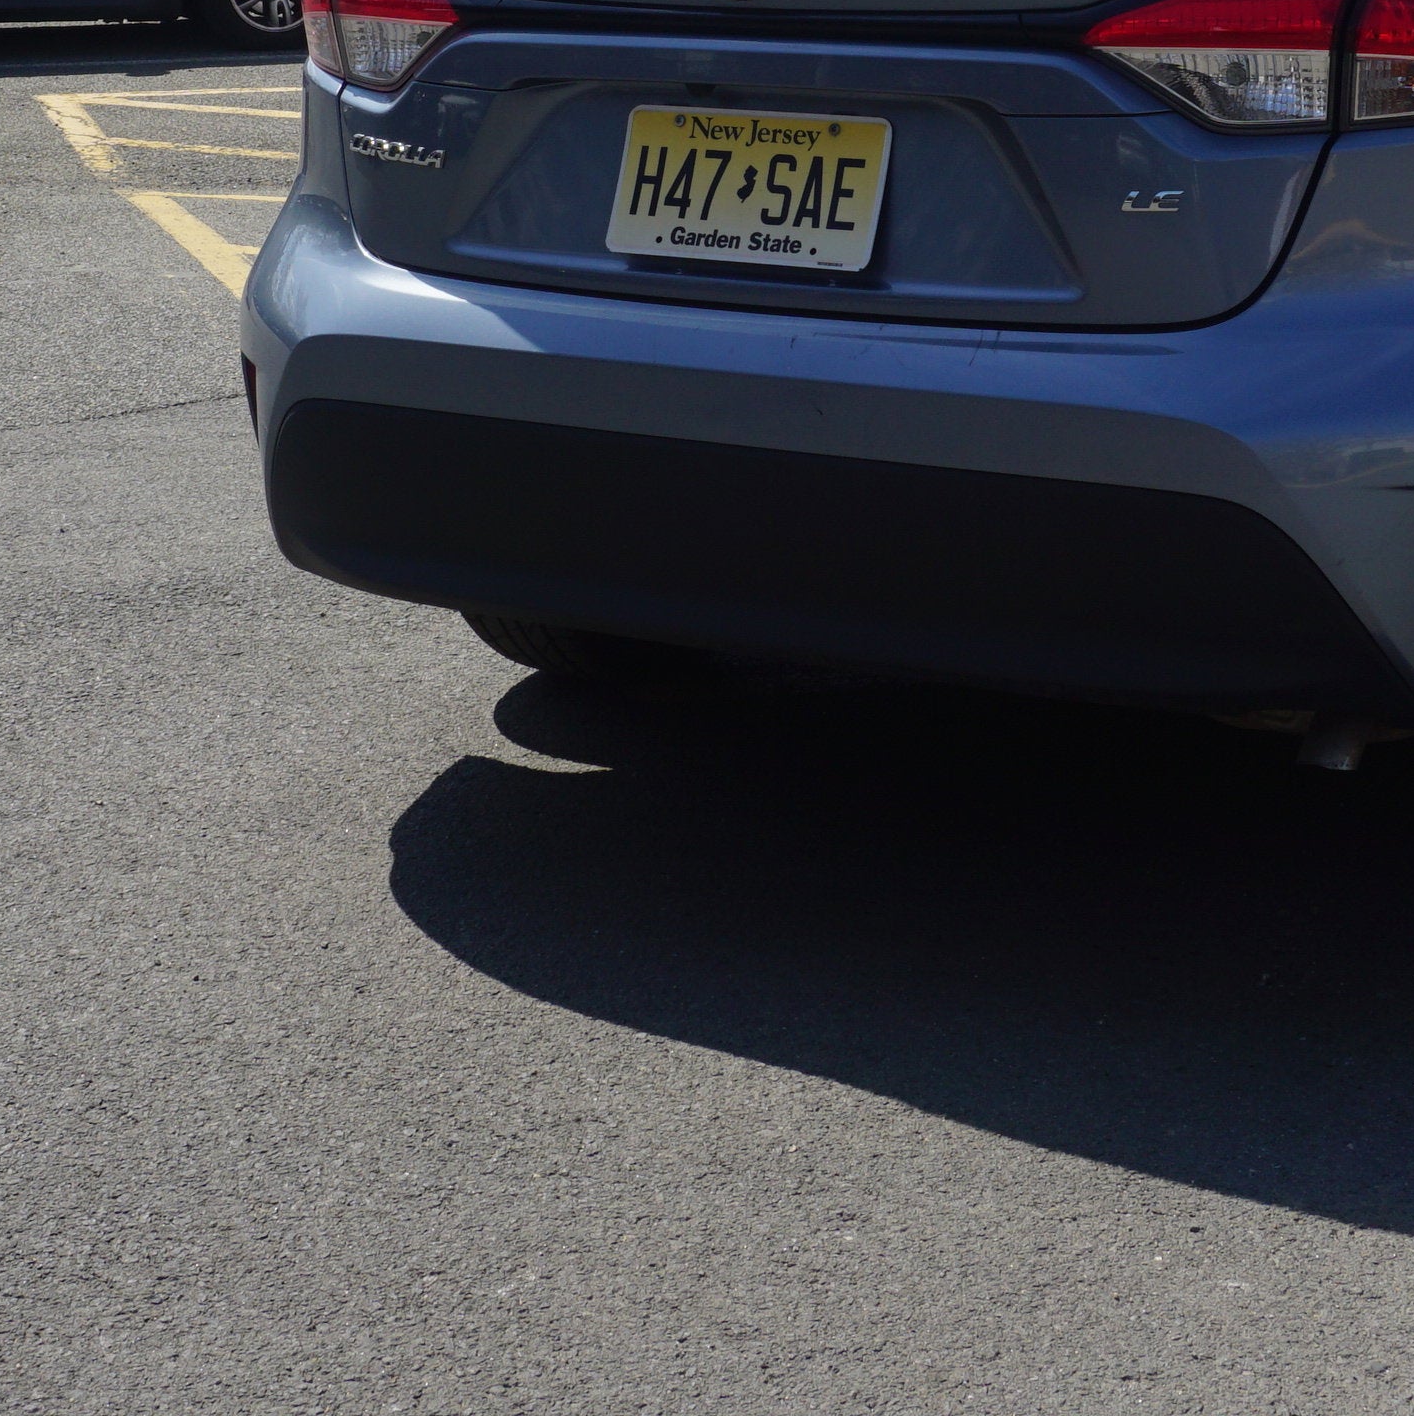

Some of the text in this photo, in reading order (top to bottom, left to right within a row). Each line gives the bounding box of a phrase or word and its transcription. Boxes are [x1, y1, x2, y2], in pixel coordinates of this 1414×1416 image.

[349, 133, 446, 168] COROLLA
[689, 116, 822, 151] New Jersey
[629, 145, 866, 231] H47 SAE
[1121, 190, 1185, 212] LE
[670, 226, 803, 254] Garden State
